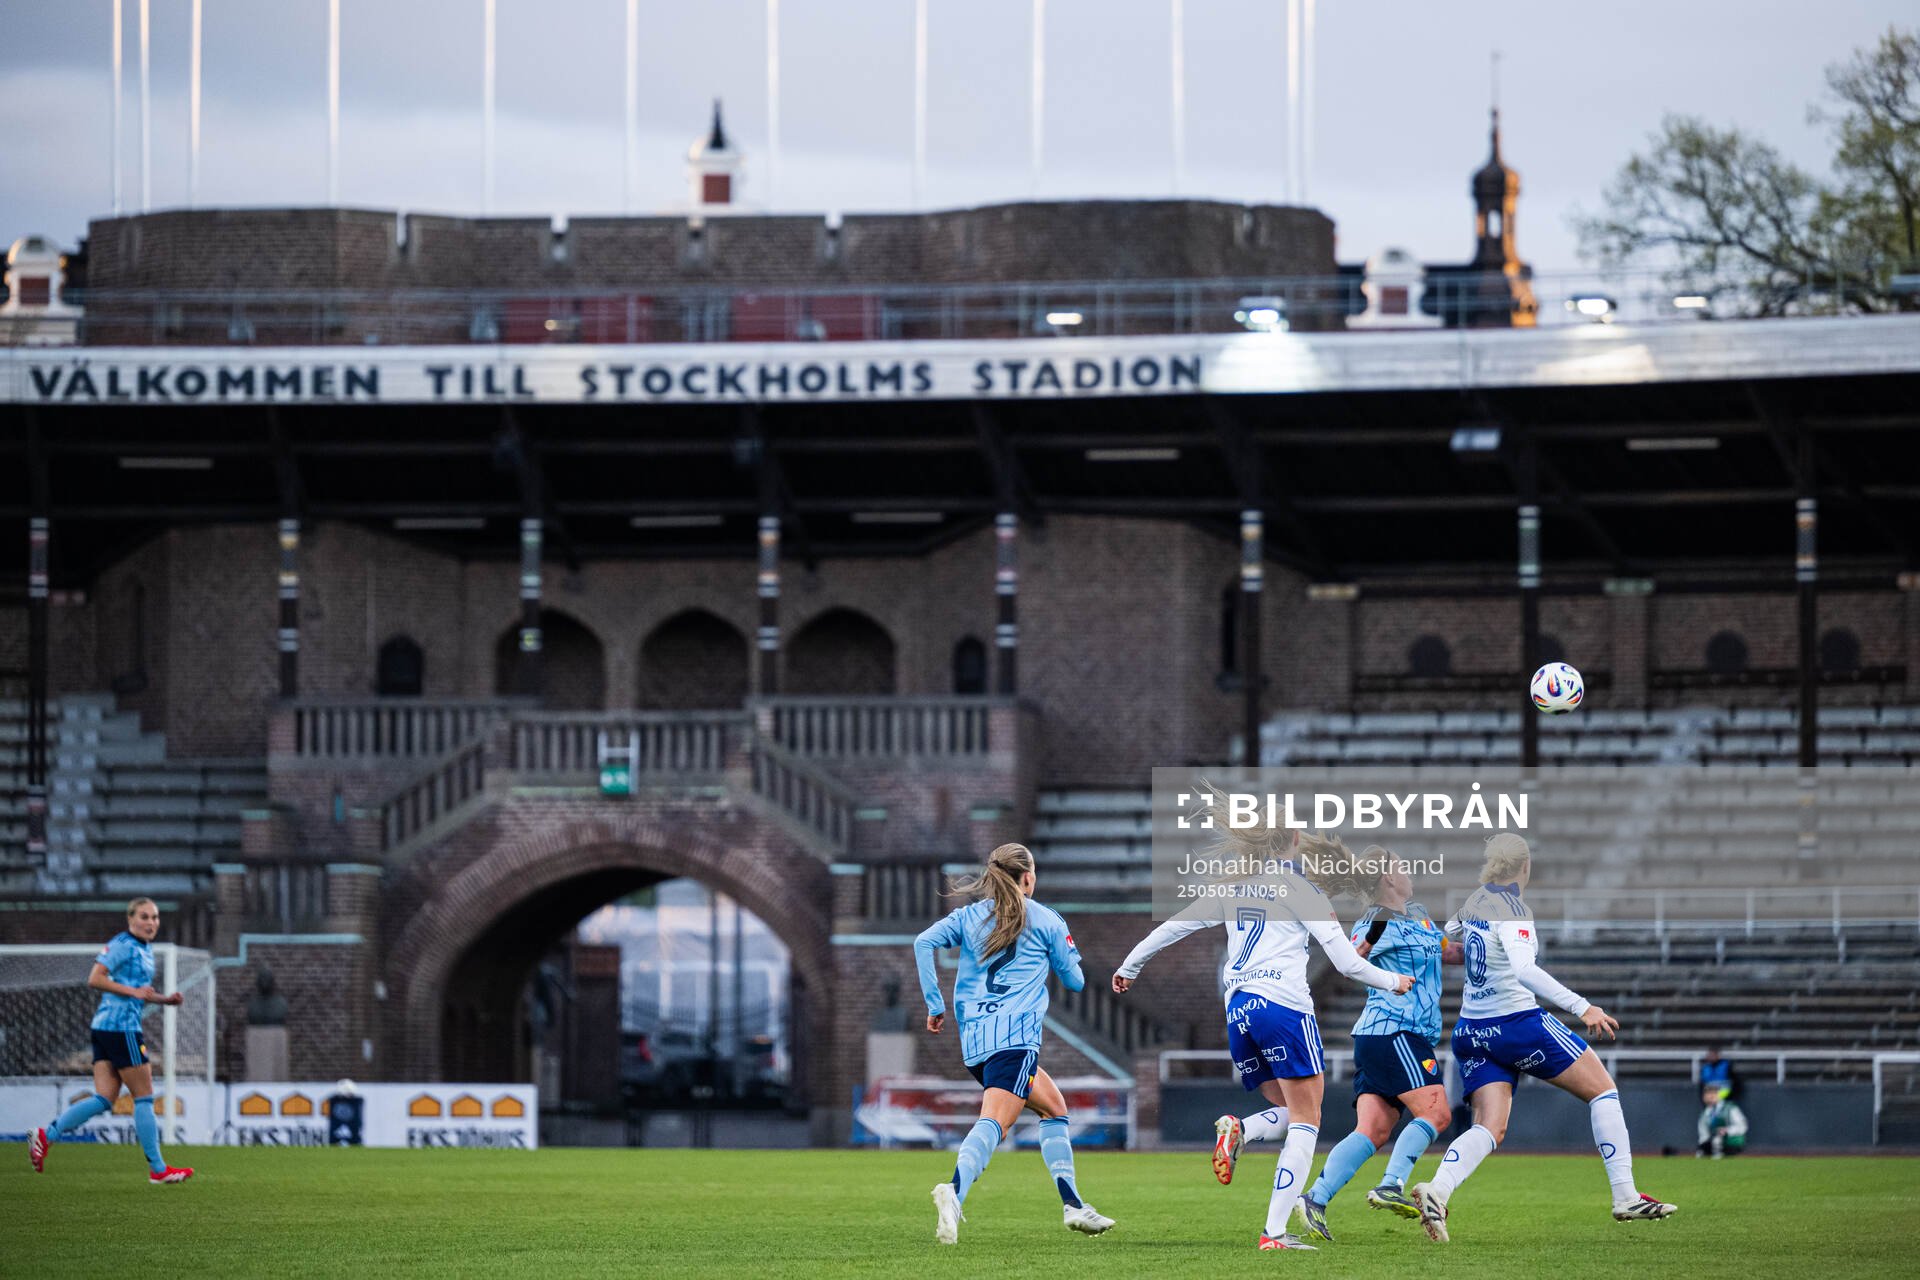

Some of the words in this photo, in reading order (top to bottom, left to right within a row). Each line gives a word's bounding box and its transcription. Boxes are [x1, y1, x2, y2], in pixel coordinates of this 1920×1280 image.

[29, 360, 381, 398] VÄLKOMMEN
[424, 364, 534, 397] TILL
[579, 361, 934, 399] STOCKHOLMS
[973, 354, 1202, 393] STADION
[1231, 907, 1267, 971] 7
[985, 937, 1016, 994] 2
[977, 1001, 1004, 1014] TC
